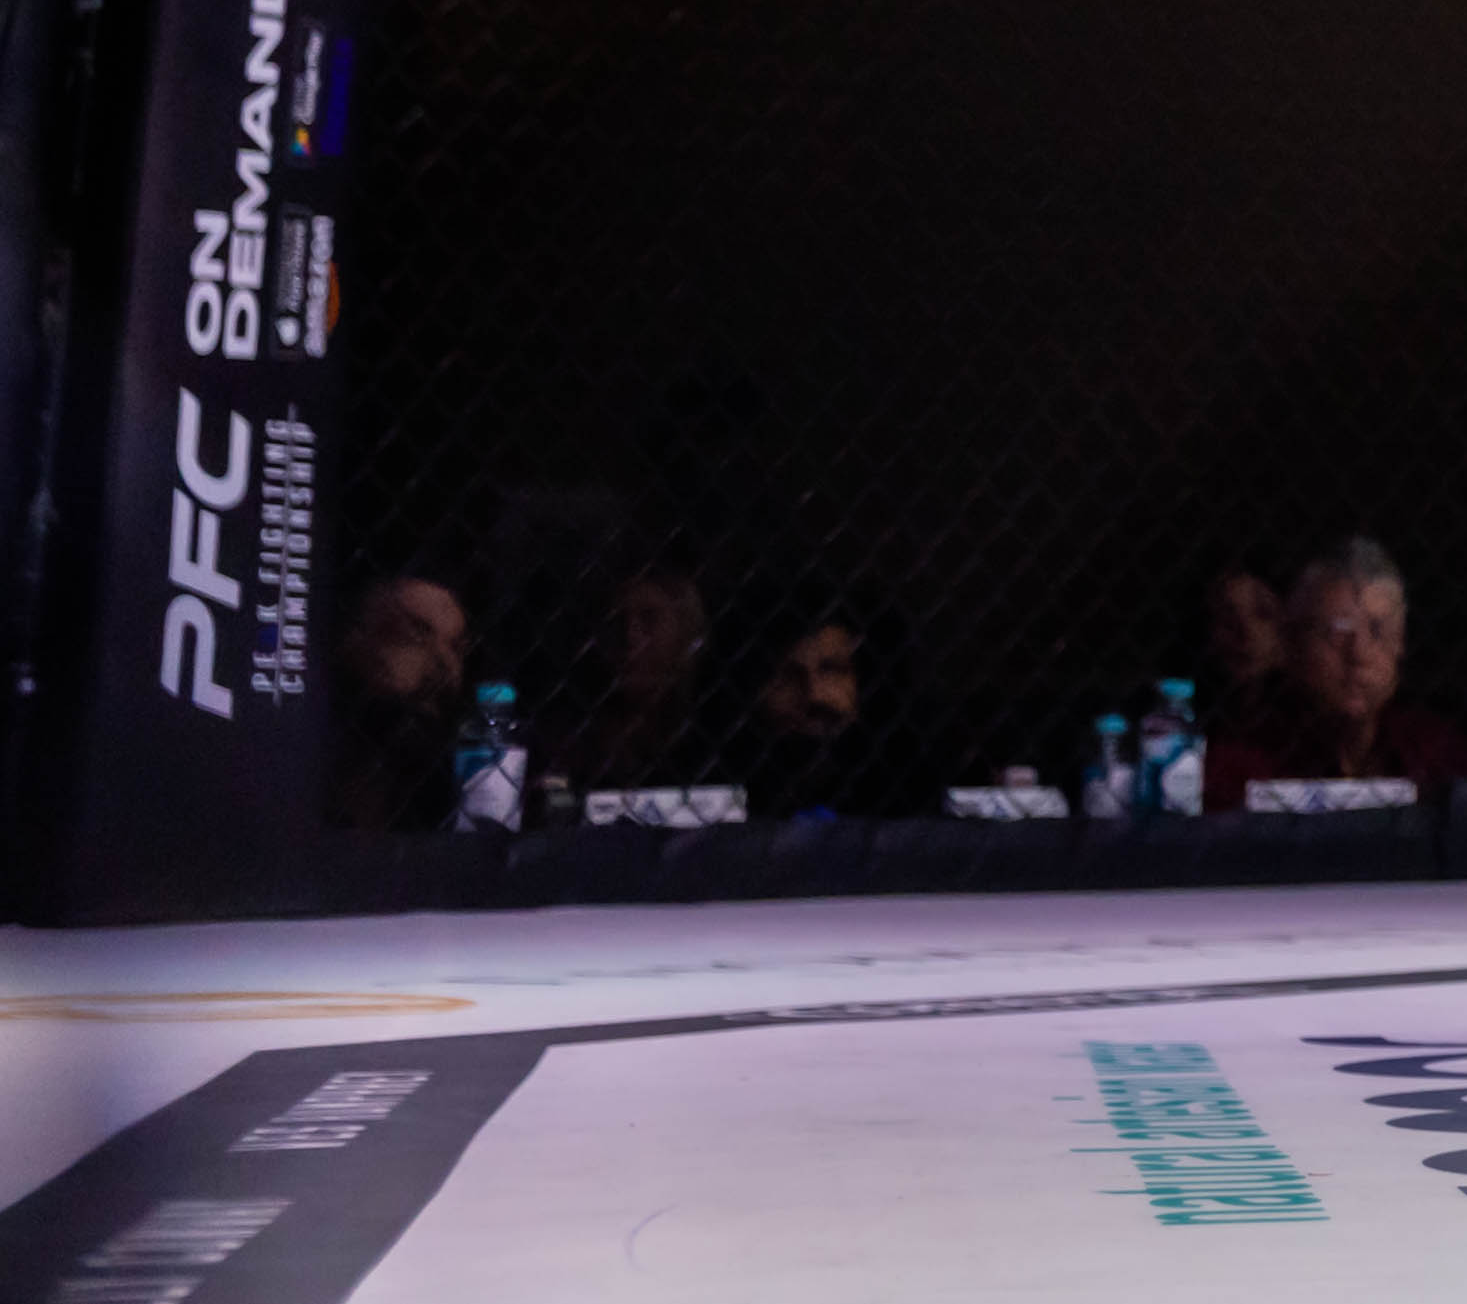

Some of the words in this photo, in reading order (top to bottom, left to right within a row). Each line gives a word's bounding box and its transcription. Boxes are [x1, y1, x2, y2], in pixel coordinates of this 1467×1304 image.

[185, 207, 231, 357] ON
[158, 385, 253, 720] PFC
[256, 418, 290, 585] FIGHTING
[278, 421, 317, 695] CHAMPIONSHIP
[1071, 1144, 1331, 1226] natural
